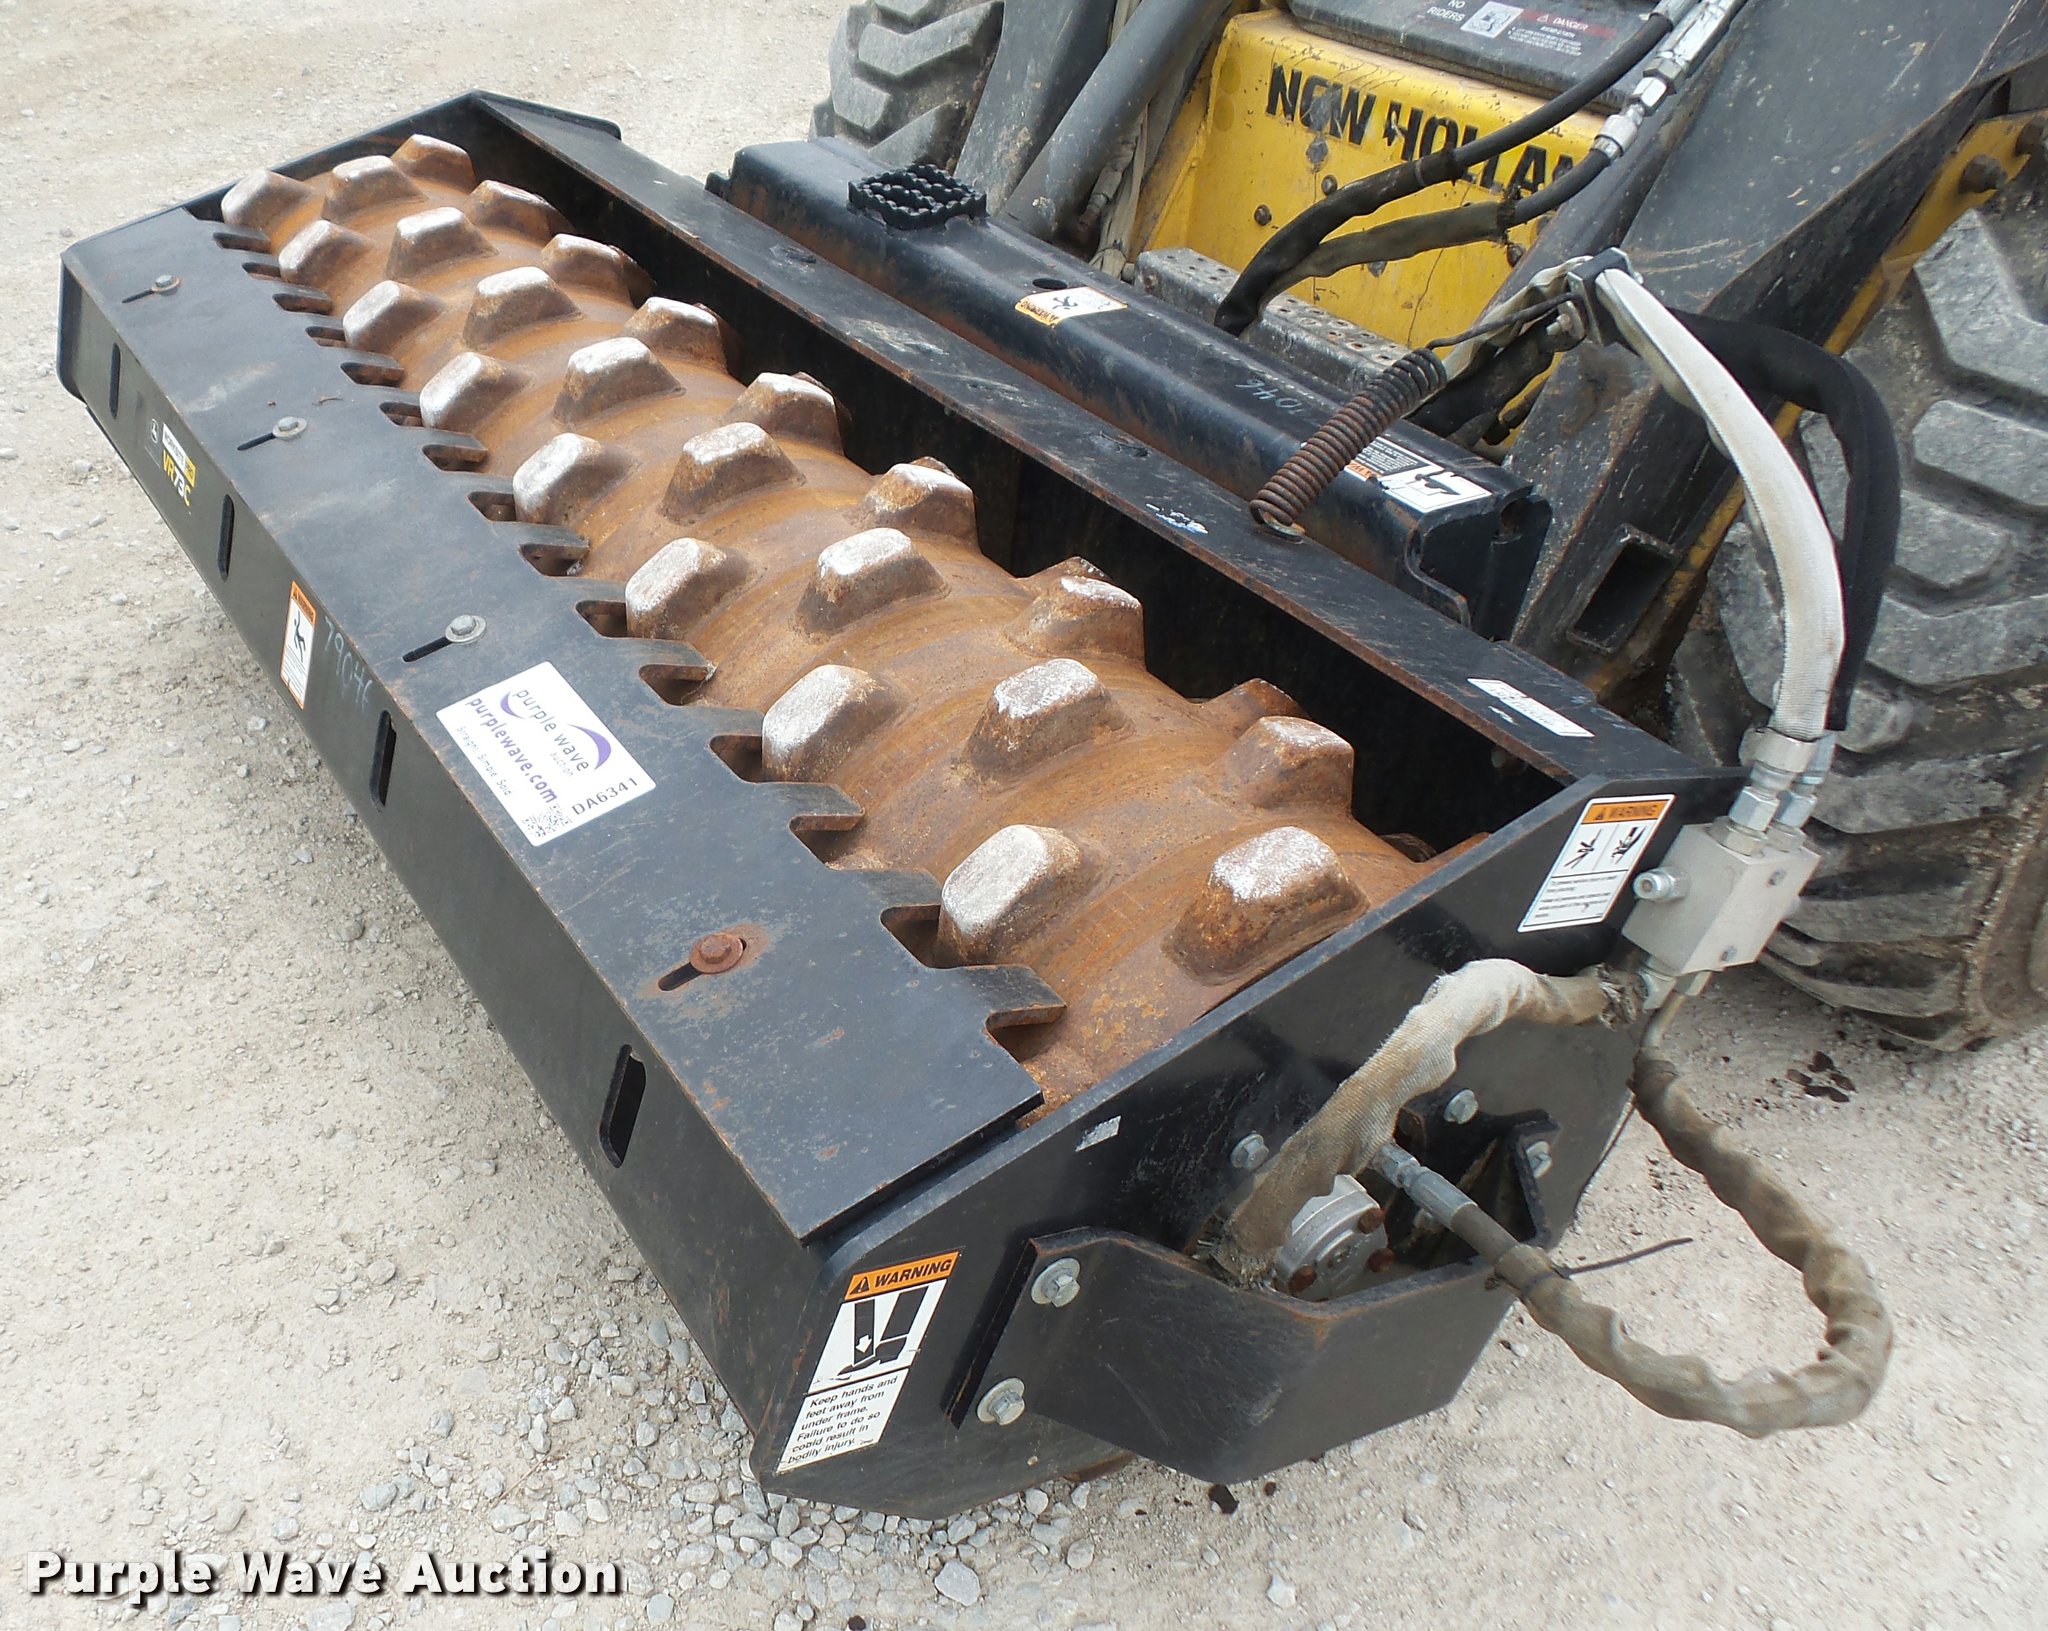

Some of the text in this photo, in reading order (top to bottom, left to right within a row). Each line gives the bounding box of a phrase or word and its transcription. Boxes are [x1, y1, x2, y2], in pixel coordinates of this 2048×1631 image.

[1427, 6, 1466, 21] RIDERS
[1448, 0, 1465, 9] NO
[1552, 17, 1589, 30] DANGER
[163, 449, 191, 507] VR73C
[512, 689, 589, 773] purple wave
[465, 697, 558, 804] purplewave.com
[550, 752, 574, 777] auction
[572, 777, 638, 815] DA6341
[875, 1259, 952, 1288] WARNING
[806, 1391, 885, 1419] feet away from
[810, 1376, 898, 1408] Keep hands and
[797, 1411, 881, 1441] Failure to do so
[801, 1406, 869, 1430] under frame.
[792, 1424, 869, 1453] could result in
[788, 1447, 822, 1464] bodily
